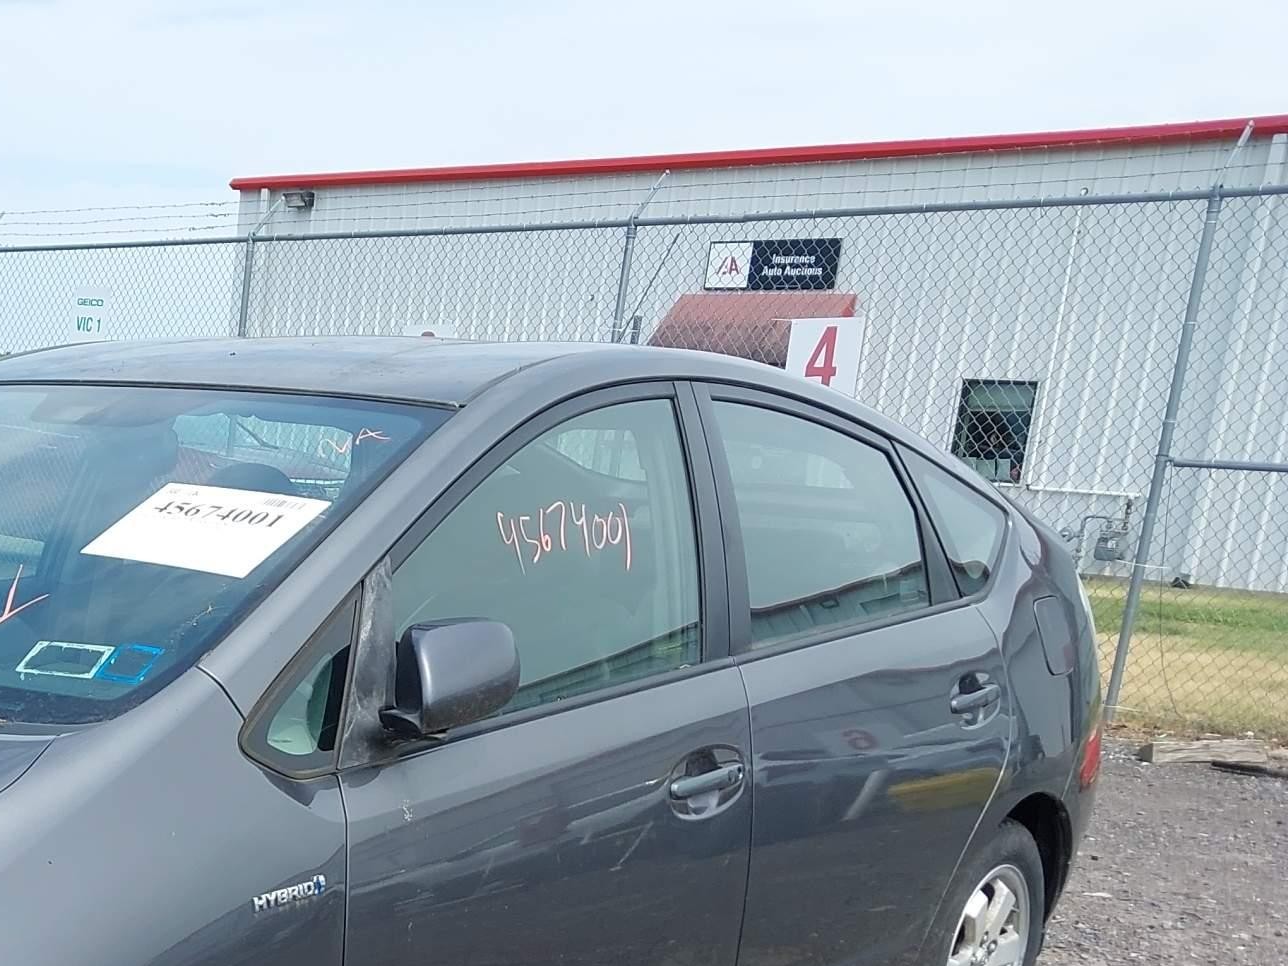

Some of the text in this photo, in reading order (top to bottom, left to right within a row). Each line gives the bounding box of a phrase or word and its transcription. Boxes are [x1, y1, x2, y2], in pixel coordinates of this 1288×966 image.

[772, 253, 816, 264] Insurance
[761, 264, 823, 276] Auto Auctions
[77, 298, 104, 306] GEICO
[77, 316, 101, 332] VIC 1
[804, 326, 837, 386] 4
[155, 501, 285, 527] 45674001
[497, 500, 631, 574] 45674001
[252, 881, 314, 912] HYBRID
